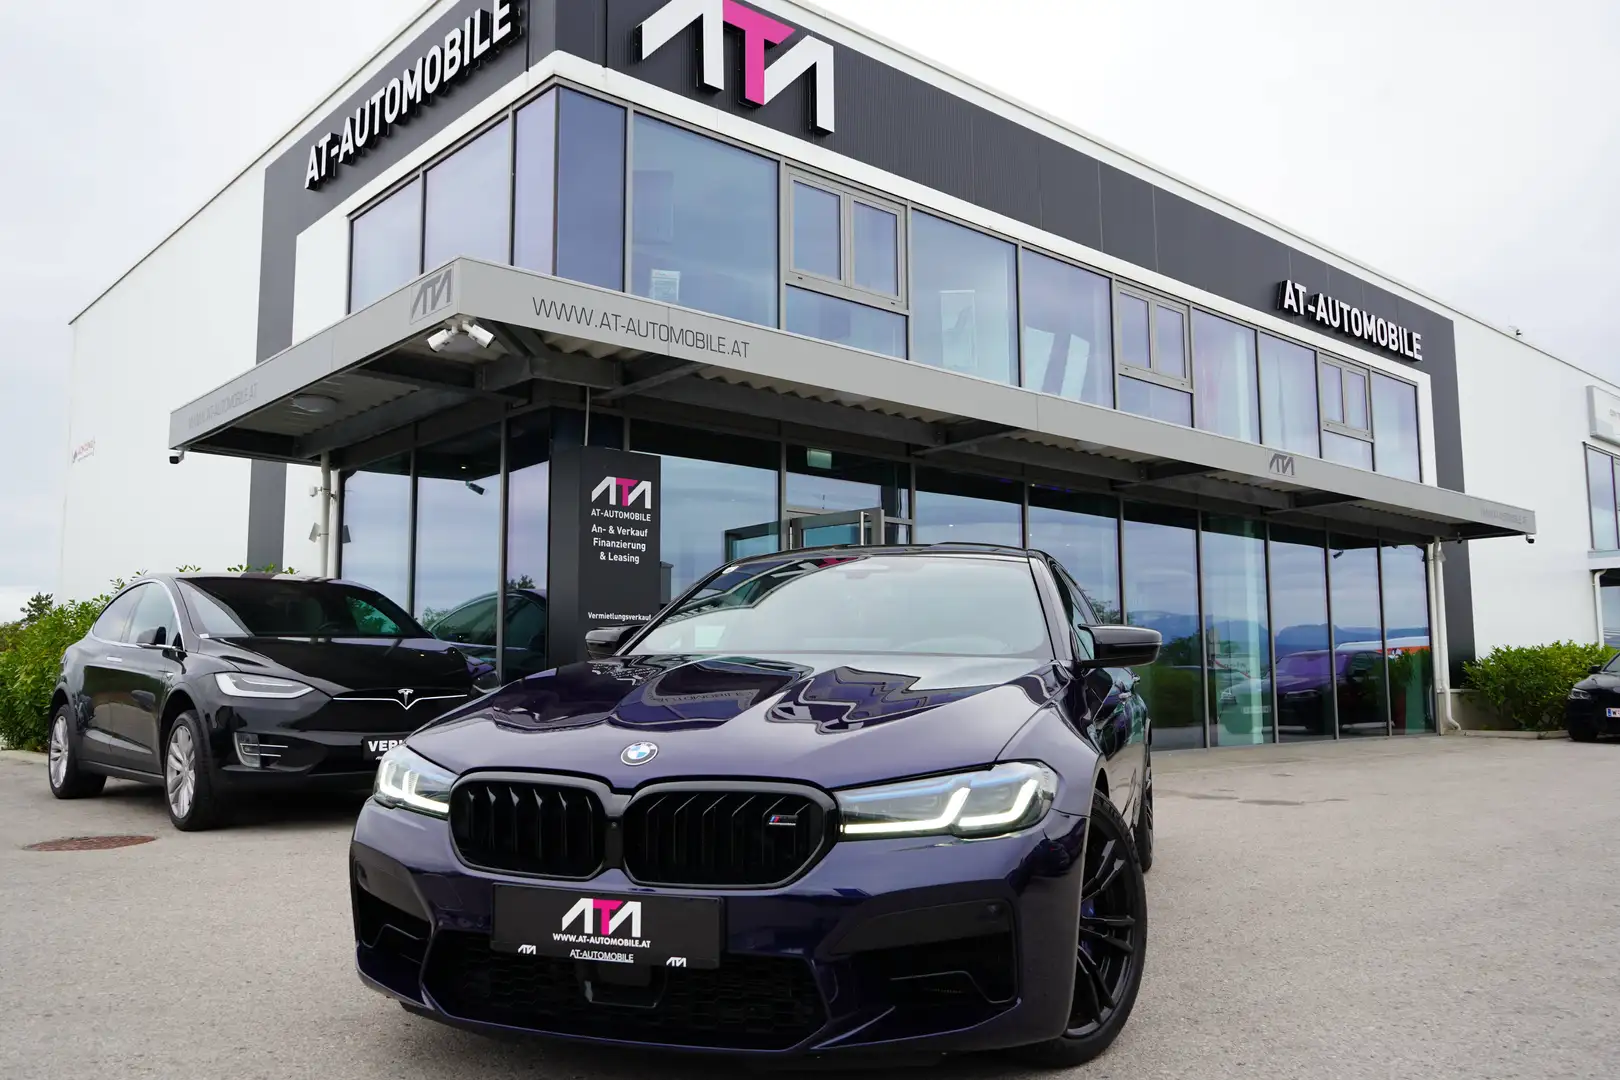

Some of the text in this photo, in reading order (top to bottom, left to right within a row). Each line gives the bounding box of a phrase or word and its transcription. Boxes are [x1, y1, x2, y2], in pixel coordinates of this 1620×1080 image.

[305, 0, 512, 189] AT-AUTOMOBILE
[532, 297, 750, 358] WWW.AT-AUTOMOBILE.AT
[1284, 280, 1423, 361] AT-AUTOMOBILE
[591, 508, 652, 521] AT-AUTOMOBILE
[591, 524, 648, 537] An- & Verkauf
[593, 538, 646, 552] Finanzierung
[600, 552, 640, 564] & Leasing
[553, 933, 651, 948] WWW.AT-AUTOMOBILE.AT
[570, 949, 634, 962] AT-AUTOMOBILE
